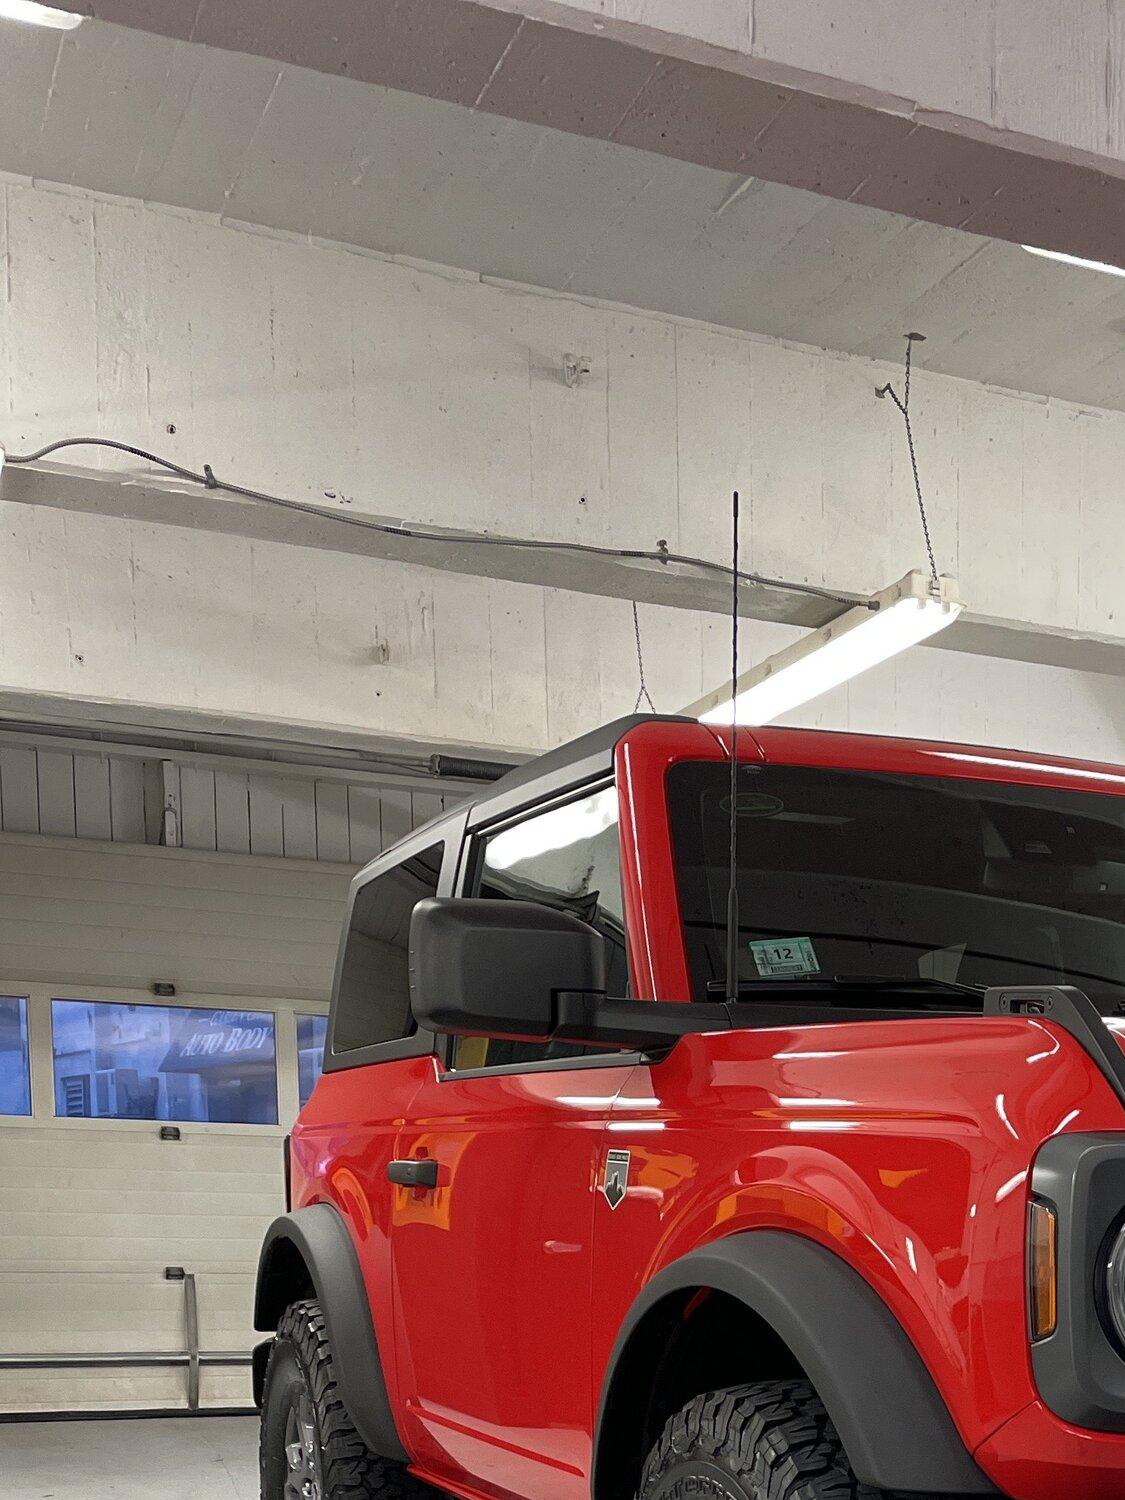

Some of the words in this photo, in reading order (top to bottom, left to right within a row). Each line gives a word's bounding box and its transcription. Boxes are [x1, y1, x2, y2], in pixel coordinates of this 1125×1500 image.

[773, 948, 794, 960] 12
[180, 1031, 225, 1057] AUTO
[223, 1027, 273, 1053] BODY
